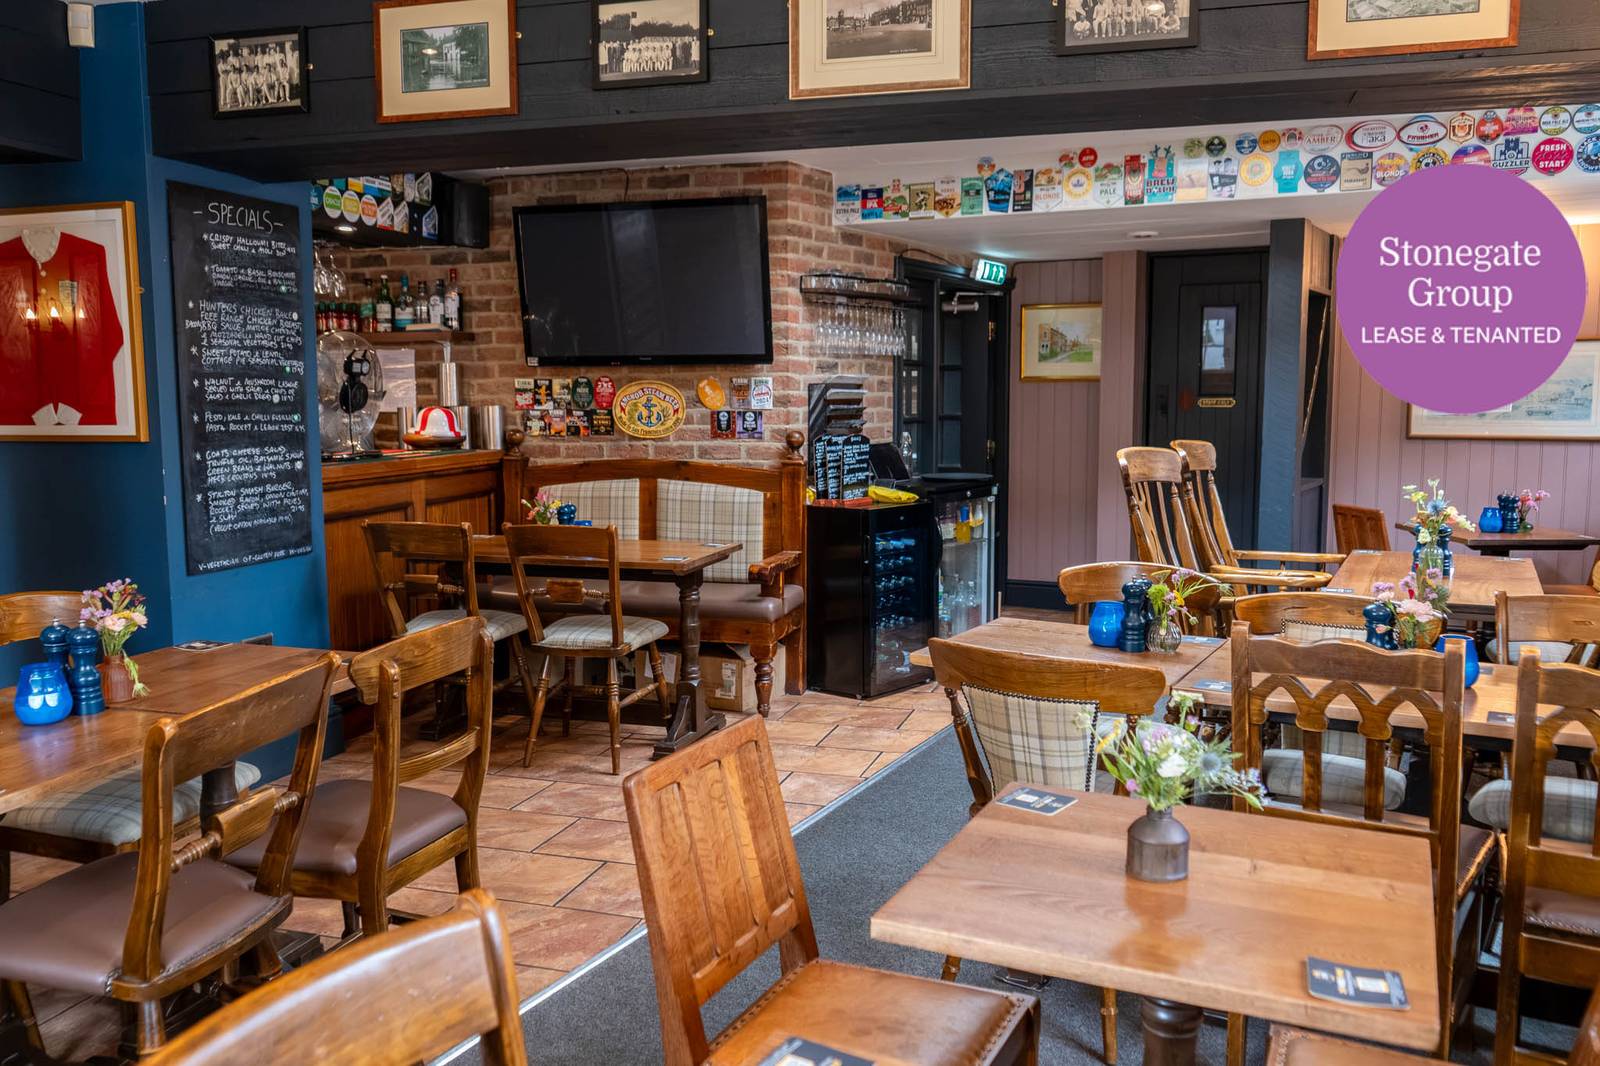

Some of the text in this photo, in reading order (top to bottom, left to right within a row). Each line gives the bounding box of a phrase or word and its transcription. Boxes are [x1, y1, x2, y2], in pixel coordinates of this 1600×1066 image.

[1305, 136, 1336, 145] AMBER
[1540, 144, 1567, 152] FRESH
[1492, 160, 1530, 168] GUZZLER
[1539, 160, 1566, 169] START
[1376, 169, 1406, 178] BLONDE
[1146, 178, 1175, 187] BREW
[1100, 188, 1117, 196] PALE
[208, 202, 274, 234] SPECIALS
[209, 233, 233, 242] CRISPY
[236, 236, 269, 247] HALLOUMI
[211, 242, 231, 250] SWEET
[210, 264, 238, 274] TOMATO
[247, 268, 266, 278] BASIL
[199, 300, 238, 313] HUNTERS
[240, 305, 273, 316] CHICKEN
[200, 311, 218, 321] FREE
[220, 313, 244, 324] RANGE
[247, 315, 277, 326] CHICKEN
[274, 335, 285, 344] CUT
[202, 348, 227, 357] SWEET
[202, 356, 233, 364] COTTAGE
[204, 378, 234, 386] WALNUT
[620, 388, 644, 408] ANCHOR
[643, 387, 666, 401] STEAM
[229, 422, 252, 431] ROCKET
[206, 449, 230, 460] GOATS
[232, 448, 260, 456] CHEESE
[206, 466, 230, 476] GREEN
[232, 464, 254, 474] BEANS
[240, 486, 264, 497] SMASH
[262, 500, 281, 508] WITH
